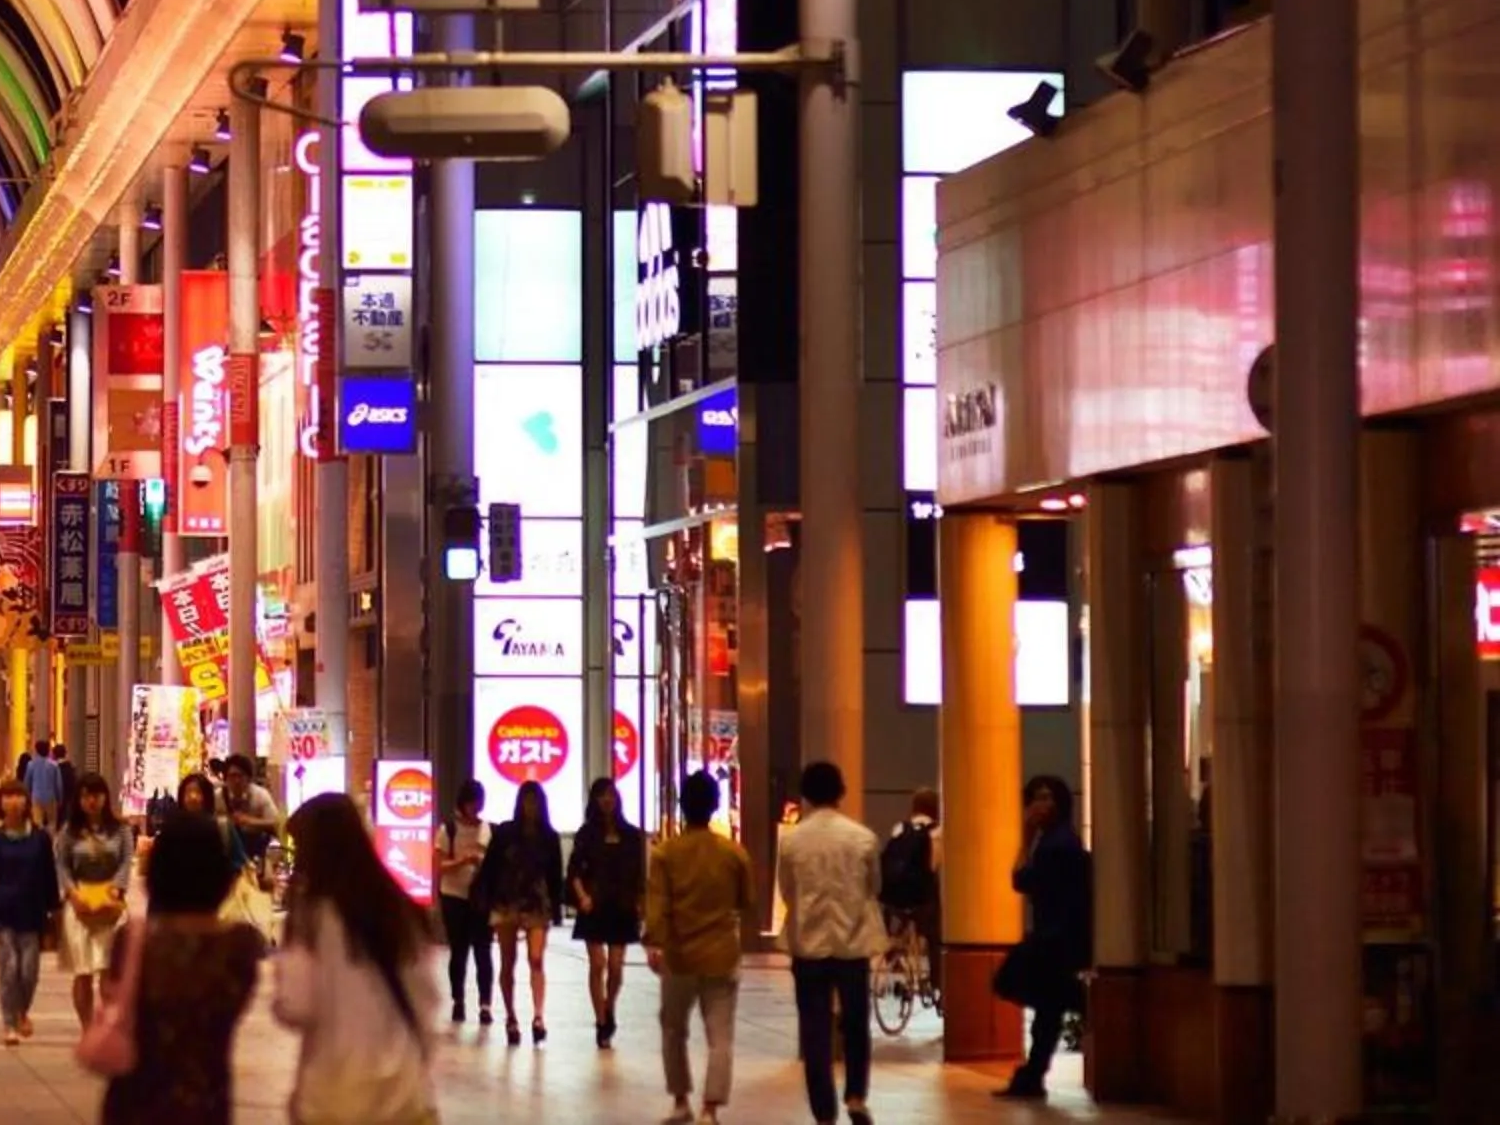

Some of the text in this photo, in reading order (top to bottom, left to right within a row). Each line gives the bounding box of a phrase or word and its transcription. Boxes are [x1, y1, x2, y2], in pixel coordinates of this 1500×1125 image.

[108, 292, 131, 306] 2F
[361, 293, 395, 309] 本通
[352, 310, 404, 327] 不動産
[185, 345, 225, 456] Wants
[109, 459, 131, 472] 1F
[56, 478, 88, 492] くすり
[498, 740, 562, 765] ガスト
